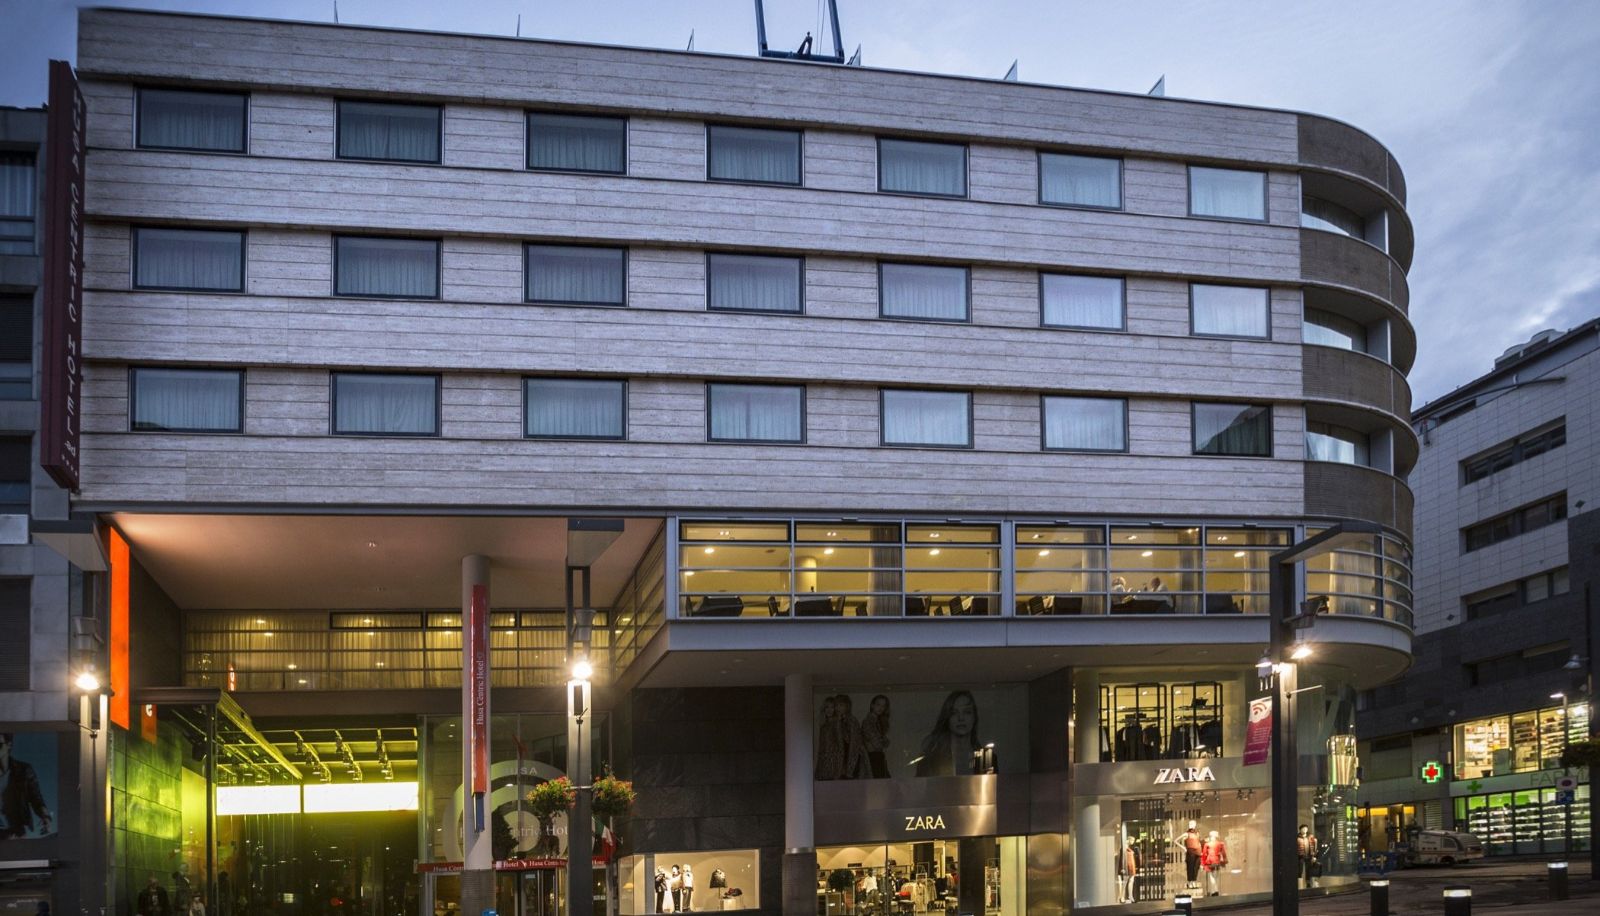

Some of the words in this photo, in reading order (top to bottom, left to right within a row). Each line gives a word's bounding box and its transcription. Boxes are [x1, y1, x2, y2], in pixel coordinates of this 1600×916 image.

[66, 333, 77, 436] HOTEL
[475, 660, 484, 679] Hotel
[1152, 766, 1216, 784] ZARA
[905, 814, 946, 830] ZARA
